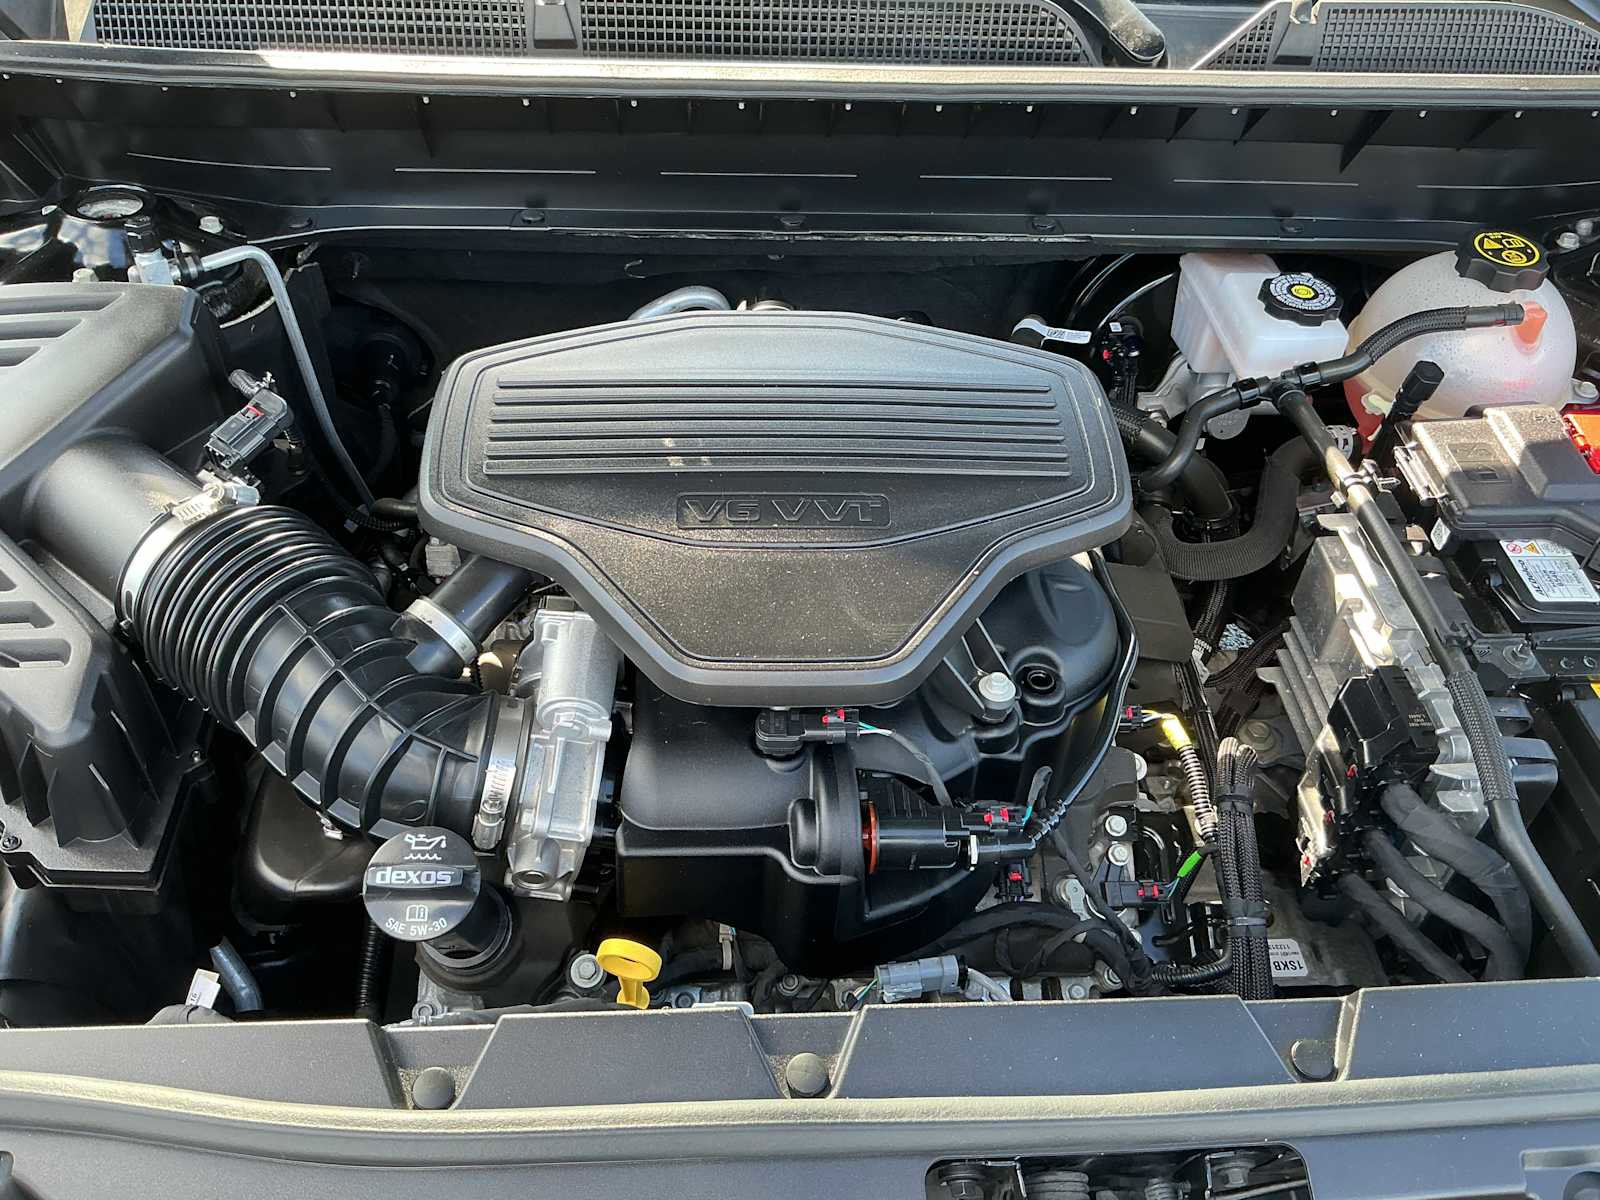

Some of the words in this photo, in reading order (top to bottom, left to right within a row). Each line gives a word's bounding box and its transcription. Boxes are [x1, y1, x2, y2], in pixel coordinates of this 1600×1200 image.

[685, 499, 761, 522] V6
[771, 499, 882, 522] VVT
[375, 866, 452, 885] dexos
[385, 917, 406, 934] SAE
[409, 917, 448, 936] 5W-30
[1273, 959, 1304, 971] 1SKB
